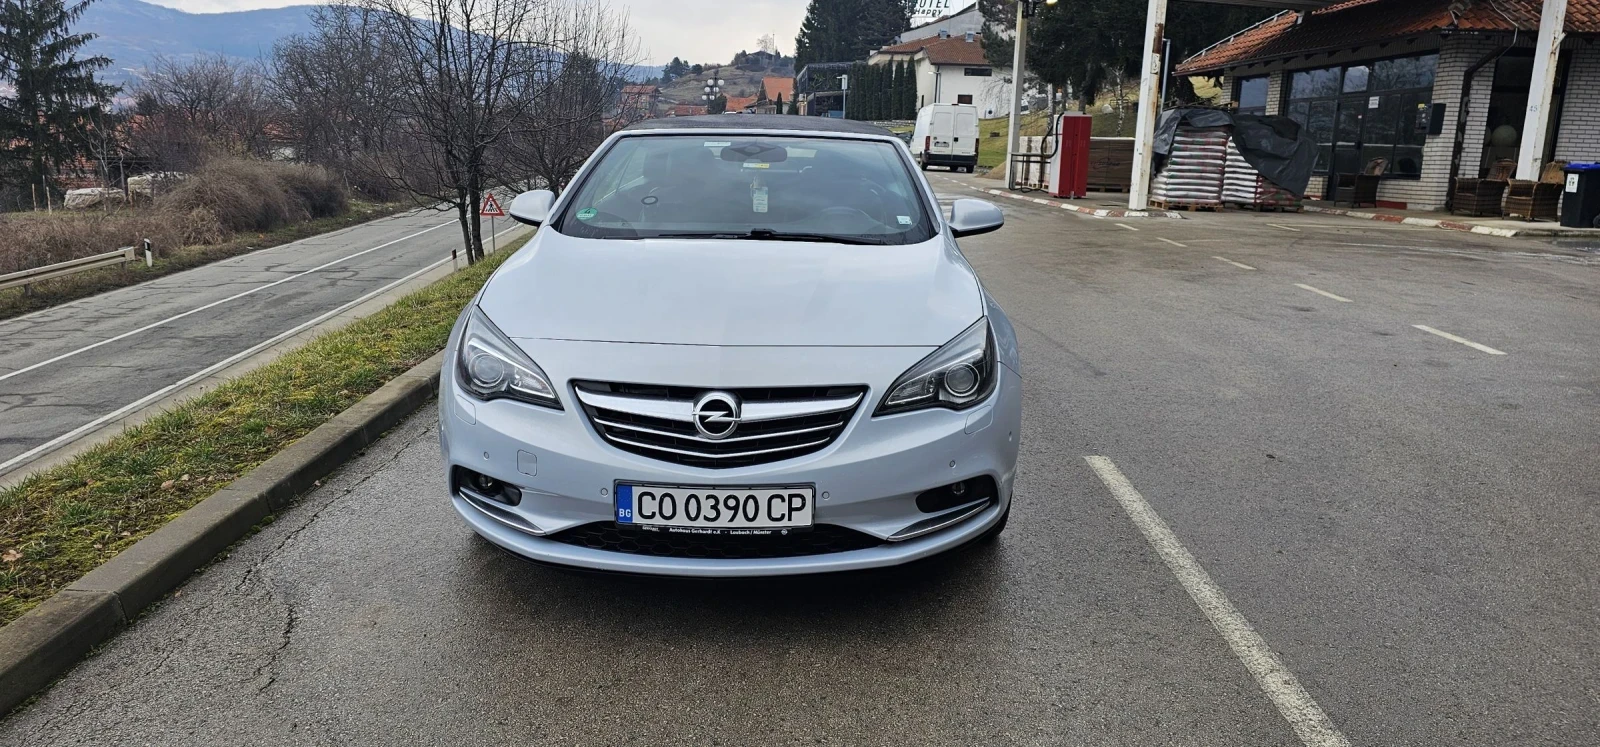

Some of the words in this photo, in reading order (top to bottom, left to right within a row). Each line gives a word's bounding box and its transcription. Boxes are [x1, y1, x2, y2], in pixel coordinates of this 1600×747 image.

[619, 508, 631, 518] BG
[637, 491, 677, 521] CO
[684, 493, 759, 523] 0390
[766, 493, 807, 522] CP
